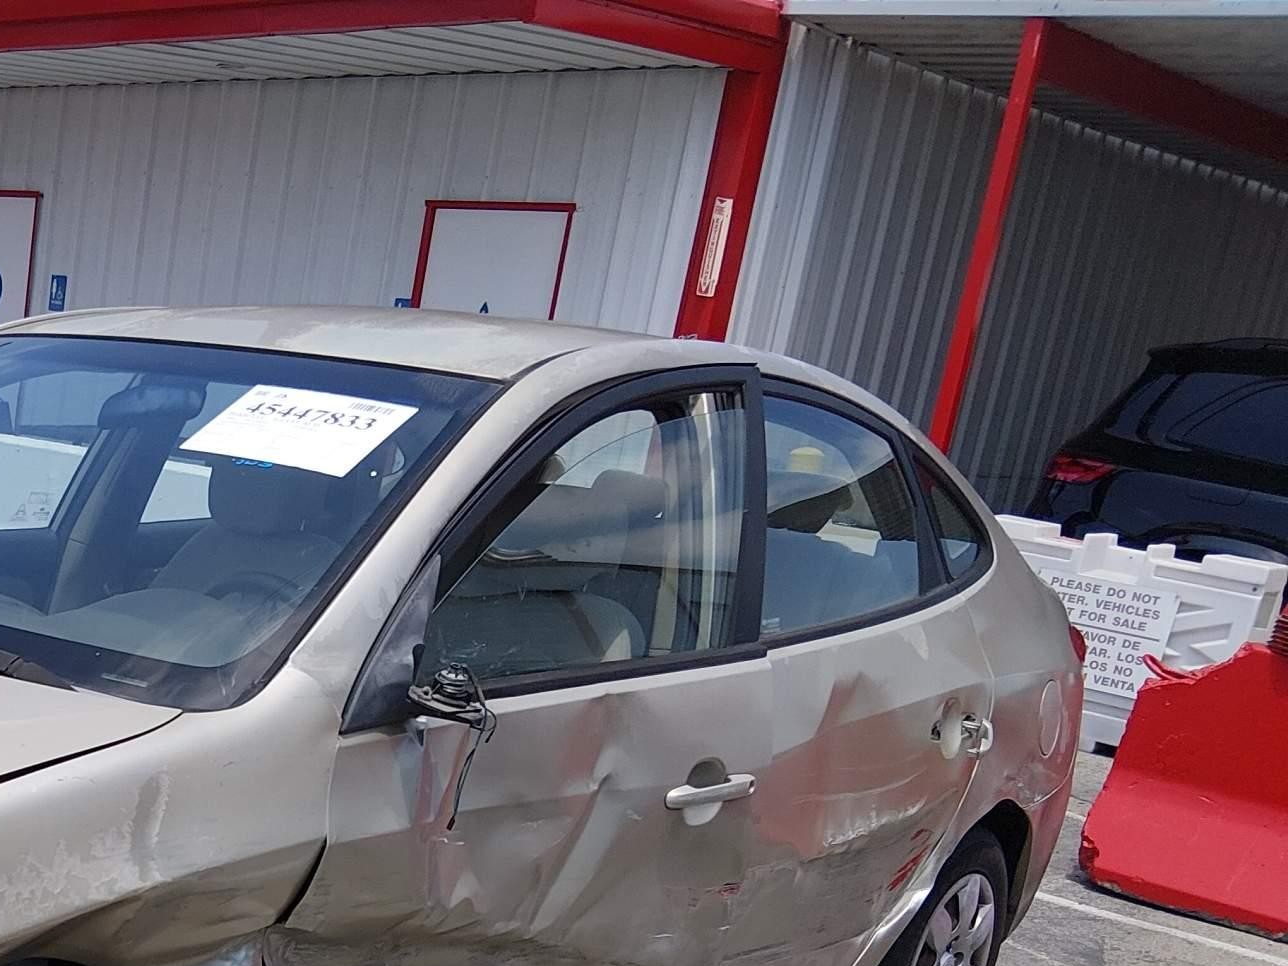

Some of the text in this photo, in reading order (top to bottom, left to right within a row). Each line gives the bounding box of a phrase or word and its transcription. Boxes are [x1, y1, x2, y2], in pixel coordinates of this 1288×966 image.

[246, 402, 377, 430] 45447833
[1050, 577, 1161, 606] PLEASE DO NOT
[1058, 592, 1089, 606] TER.
[1095, 599, 1161, 620] VEHICLES
[1078, 610, 1107, 624] FOR
[1112, 617, 1147, 631] SALE
[1081, 630, 1141, 651] AVOR DE
[1117, 652, 1144, 666] LOS
[1113, 665, 1133, 677] NO
[1093, 675, 1135, 692] VENTA
